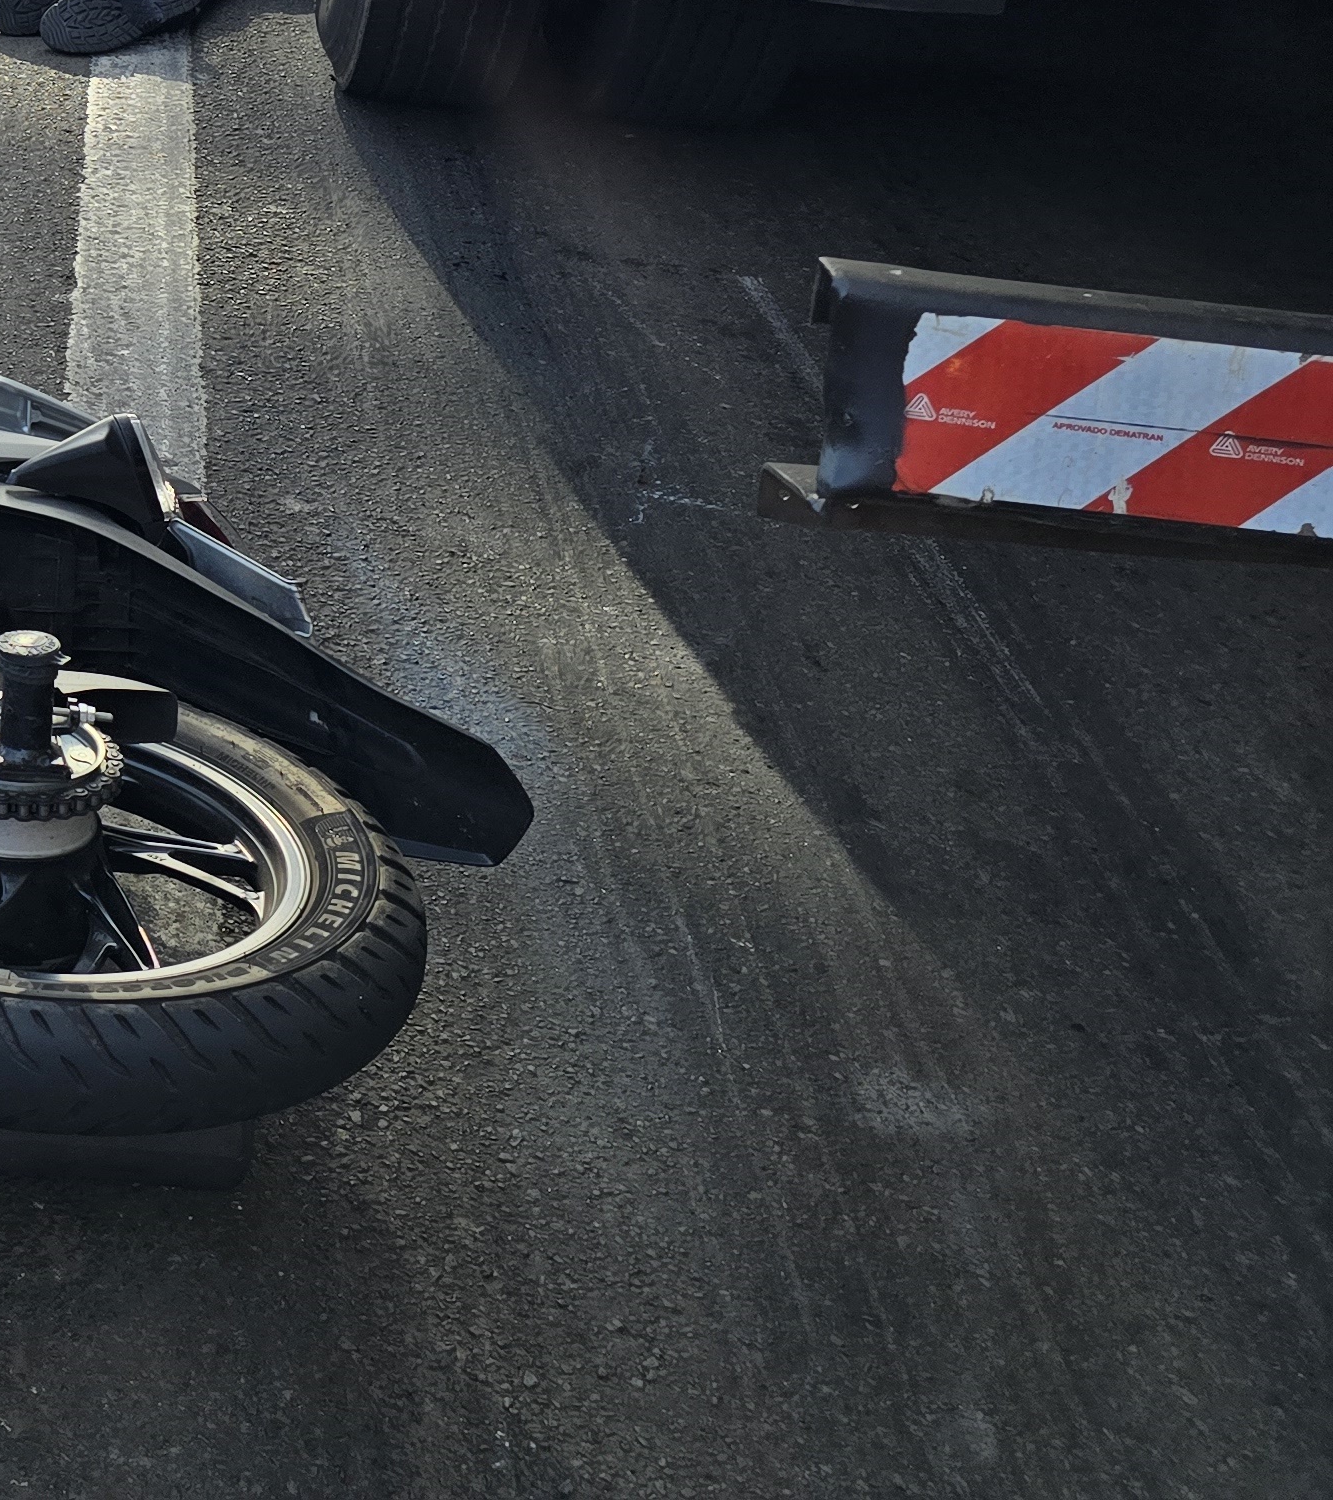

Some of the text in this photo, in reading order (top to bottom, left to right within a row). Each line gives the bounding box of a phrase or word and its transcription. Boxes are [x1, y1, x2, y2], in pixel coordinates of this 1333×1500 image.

[938, 407, 977, 419] AVERY
[938, 415, 997, 430] DENNISON
[1052, 421, 1164, 443] APROVADO DENATRAN
[1246, 445, 1284, 456] AVERY
[1245, 452, 1305, 467] DENNISON
[269, 850, 362, 963] MICHELIN
